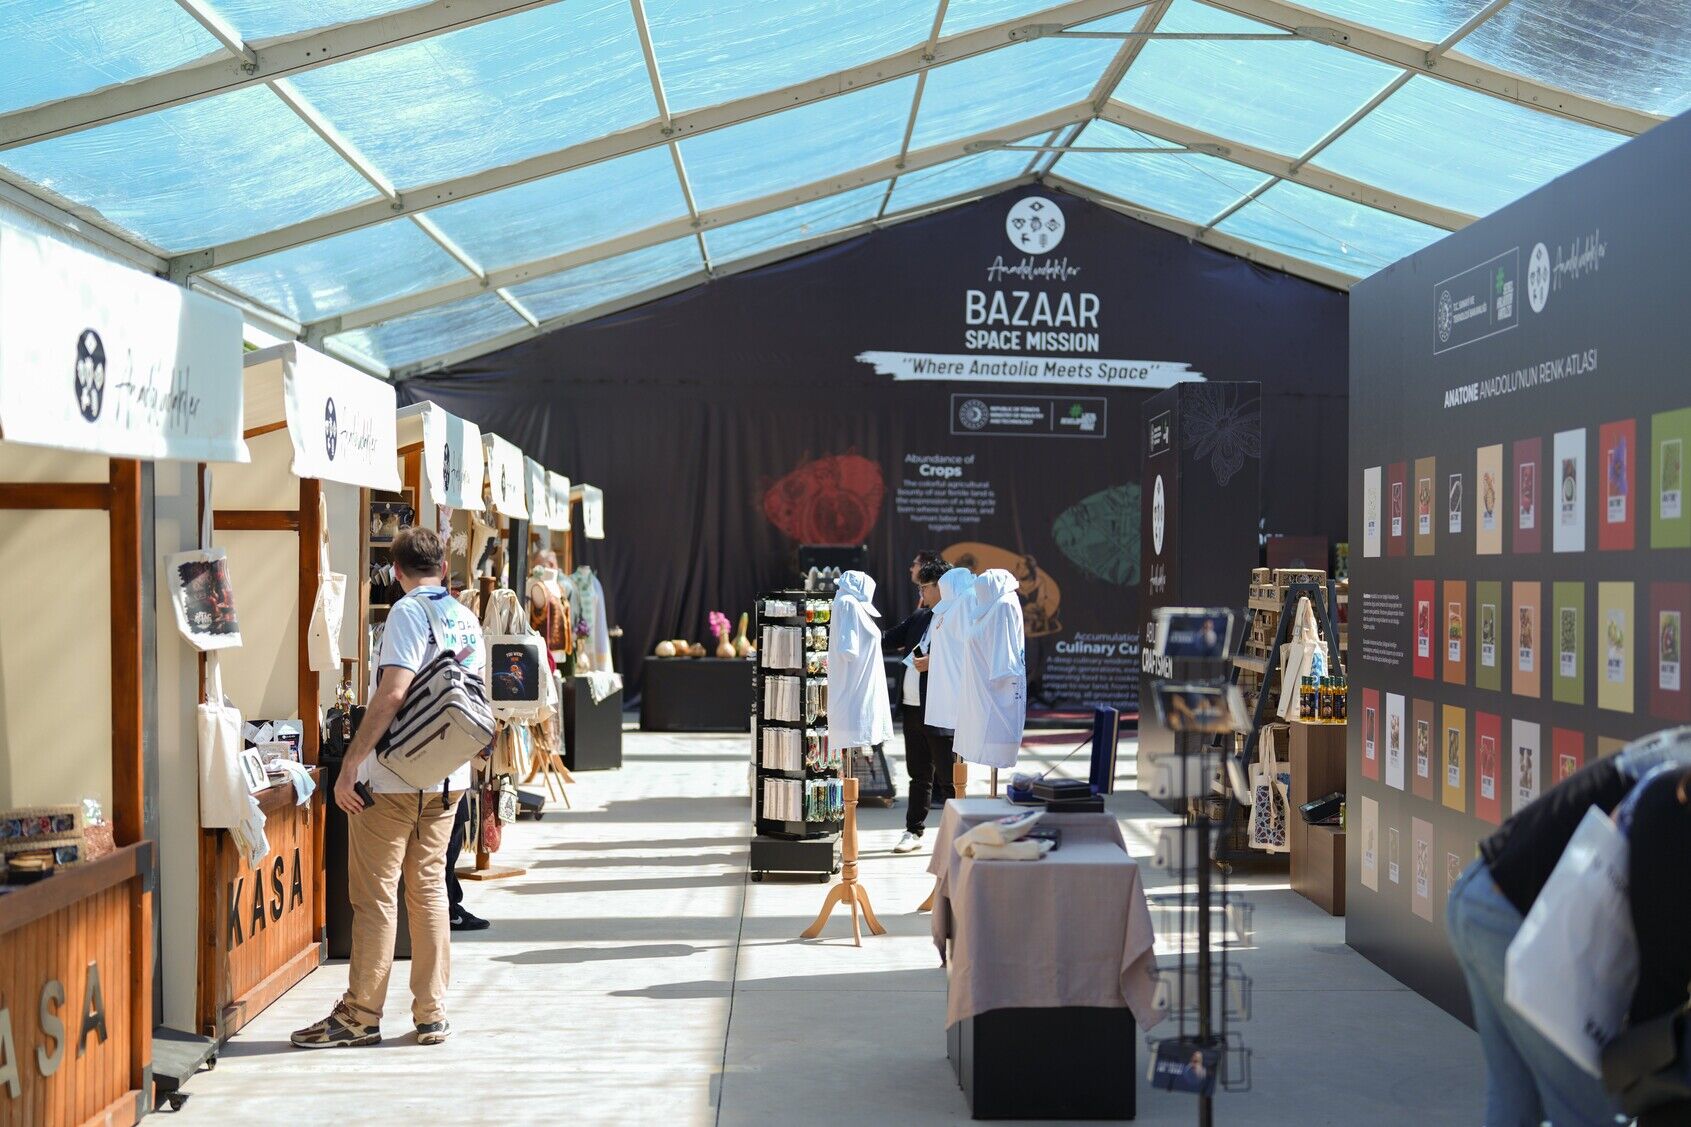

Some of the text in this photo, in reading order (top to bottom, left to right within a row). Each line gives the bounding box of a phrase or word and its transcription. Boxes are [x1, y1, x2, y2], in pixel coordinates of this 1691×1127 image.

[966, 290, 1100, 328] BAZAAR
[965, 330, 1100, 352] SPACE MISSION
[969, 359, 1039, 378] Anatolia
[1043, 361, 1092, 379] Meets
[1444, 382, 1479, 408] ANATONE
[1479, 365, 1538, 400] ANADOLU'NUN
[1539, 356, 1564, 383] RENK
[905, 454, 975, 464] Abundance of
[919, 464, 963, 479] Crops
[1056, 641, 1139, 657] Culinary Cu
[1142, 647, 1173, 679] CRAFTSMEN
[226, 847, 304, 951] KASA
[0, 960, 108, 1099] ASA
